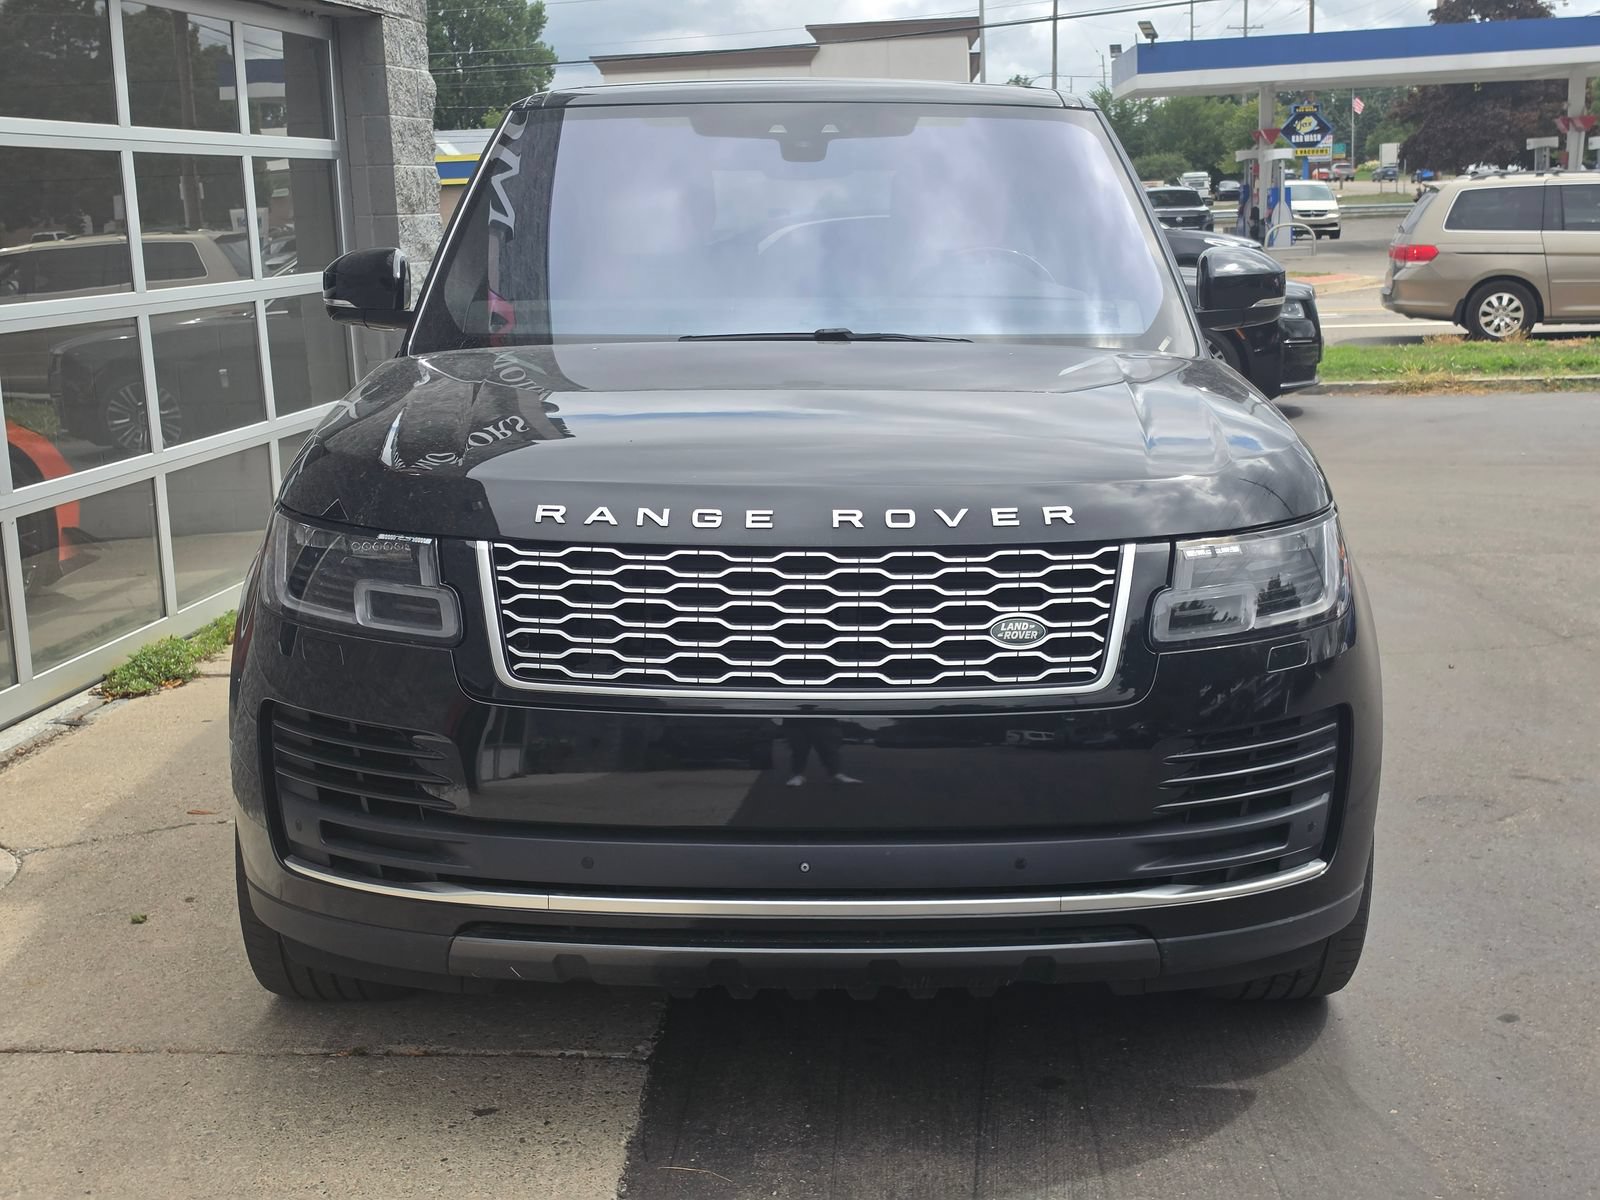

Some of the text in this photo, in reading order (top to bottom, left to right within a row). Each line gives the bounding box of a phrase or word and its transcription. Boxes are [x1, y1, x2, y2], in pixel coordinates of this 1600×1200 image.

[535, 504, 1076, 529] RANGE ROVER
[1000, 622, 1029, 631] LAND
[1003, 631, 1038, 639] ROVER
